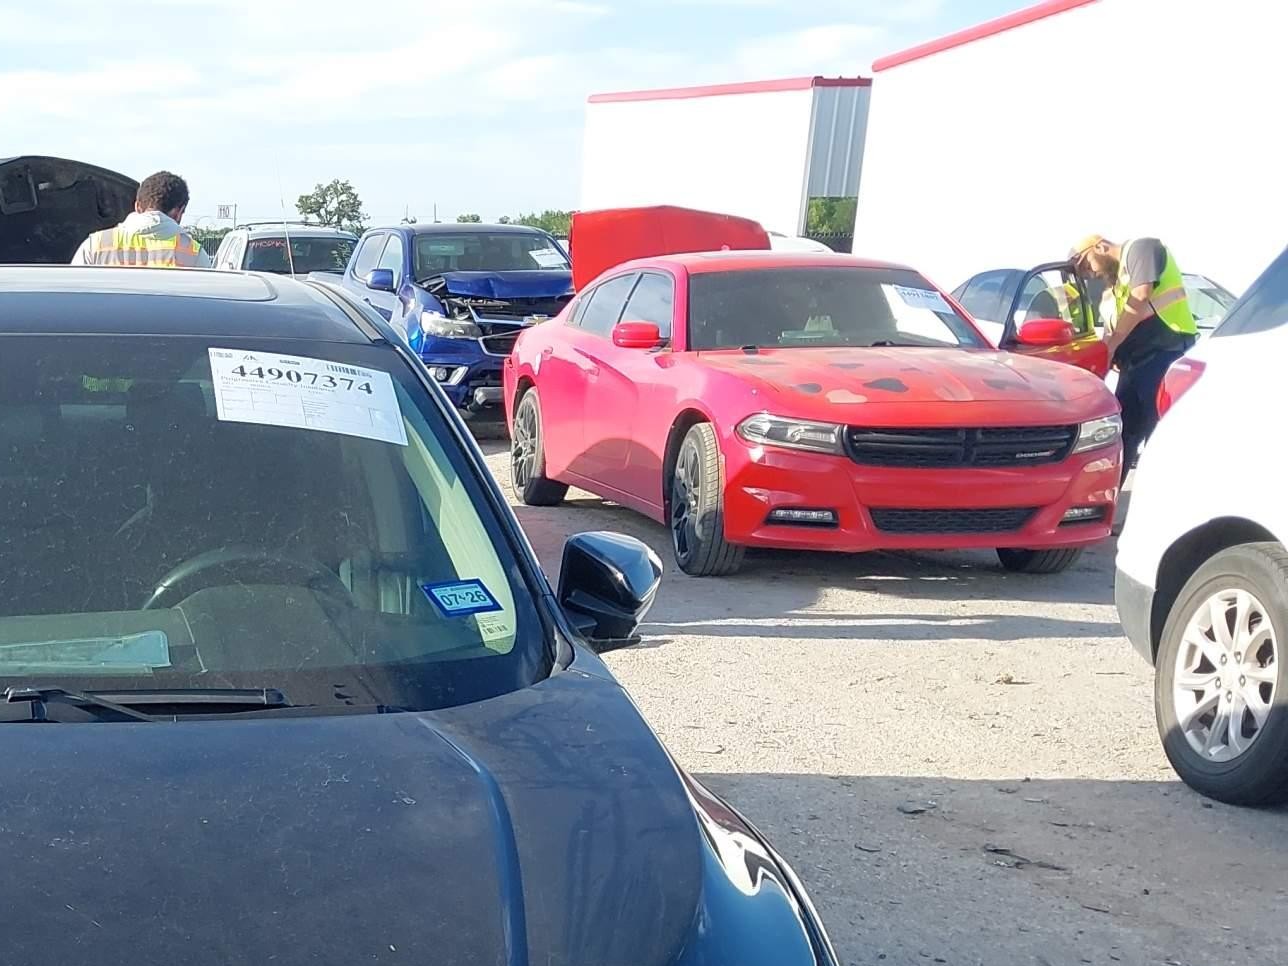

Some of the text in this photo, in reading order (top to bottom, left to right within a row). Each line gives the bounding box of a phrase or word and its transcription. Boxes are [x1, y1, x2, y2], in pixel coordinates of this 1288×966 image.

[232, 365, 373, 394] 44907374
[440, 590, 487, 606] 07 26
